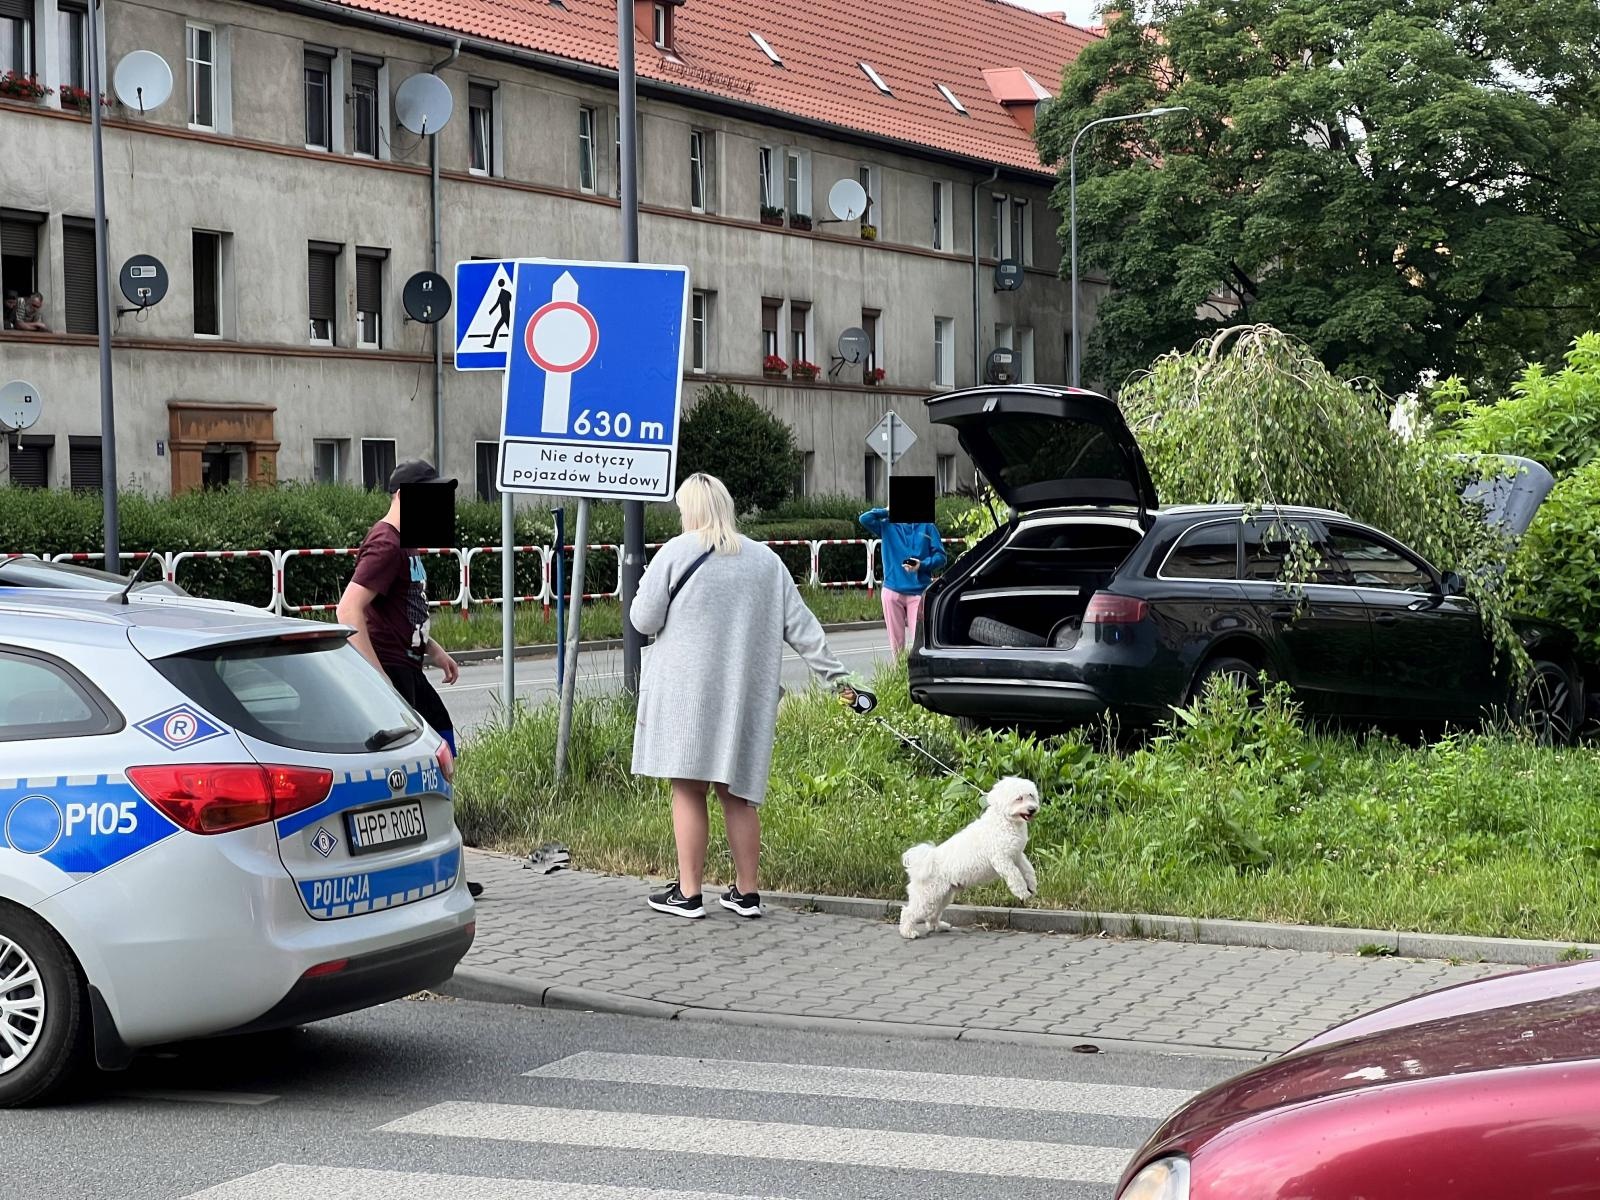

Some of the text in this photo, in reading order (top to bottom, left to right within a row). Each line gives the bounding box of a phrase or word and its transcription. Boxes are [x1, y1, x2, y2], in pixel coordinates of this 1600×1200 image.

[573, 409, 664, 440] 630 m
[540, 449, 635, 469] Nie dotyczy
[512, 467, 660, 490] pojazdów budowy
[172, 720, 188, 735] R
[391, 773, 405, 788] KIA
[422, 769, 438, 792] P105
[65, 802, 138, 837] P105
[357, 807, 422, 847] HPP R005
[313, 874, 370, 907] POLICJA
